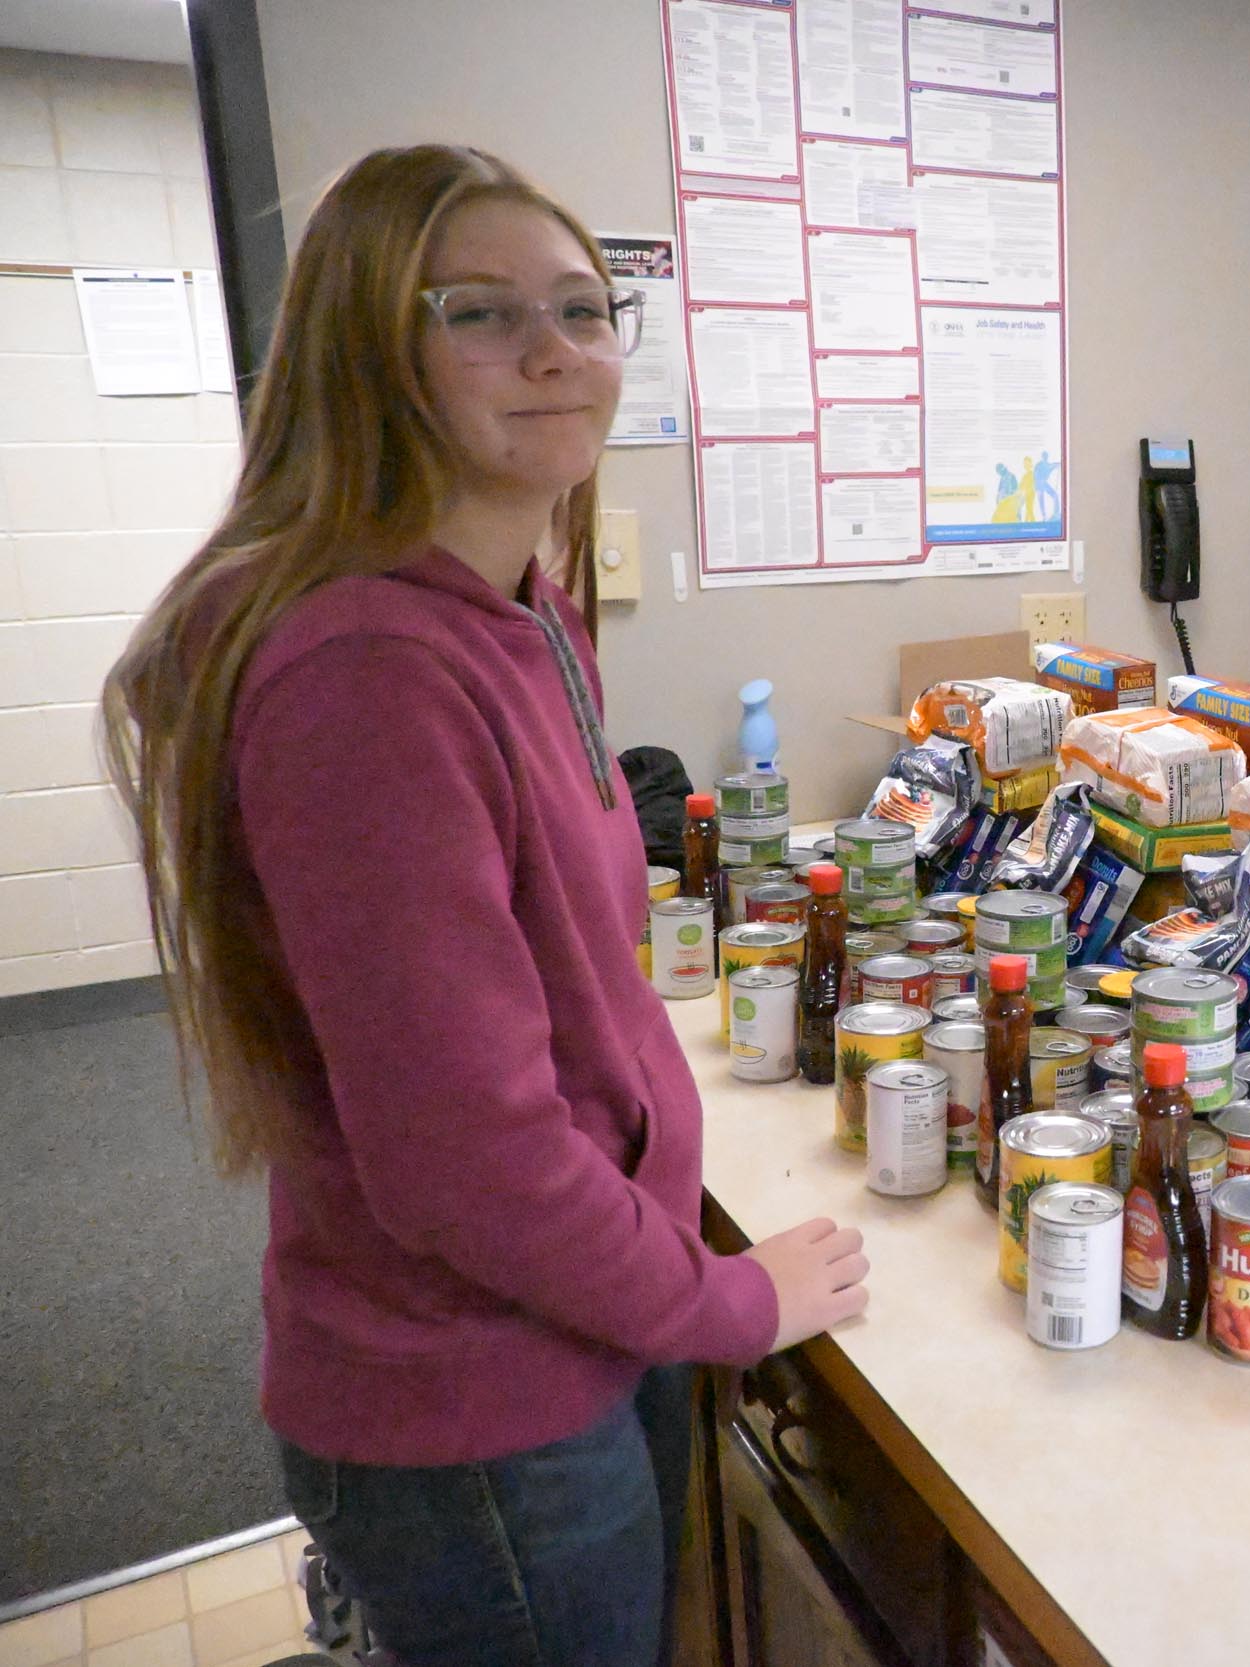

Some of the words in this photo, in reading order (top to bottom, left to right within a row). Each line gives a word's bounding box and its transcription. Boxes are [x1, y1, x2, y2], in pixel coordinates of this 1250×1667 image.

[602, 249, 651, 261] RIGHTS
[976, 319, 989, 328] Job
[989, 320, 1009, 330] Safety
[1011, 321, 1023, 329] and
[1024, 321, 1046, 330] Health
[1057, 659, 1084, 681] FAMILY
[1084, 667, 1102, 685] SIZE
[1118, 676, 1153, 690] Cheerios
[1196, 693, 1230, 716] FAMILY
[1230, 702, 1250, 723] SIZE
[1065, 813, 1080, 833] MIX
[1217, 878, 1234, 895] MIX
